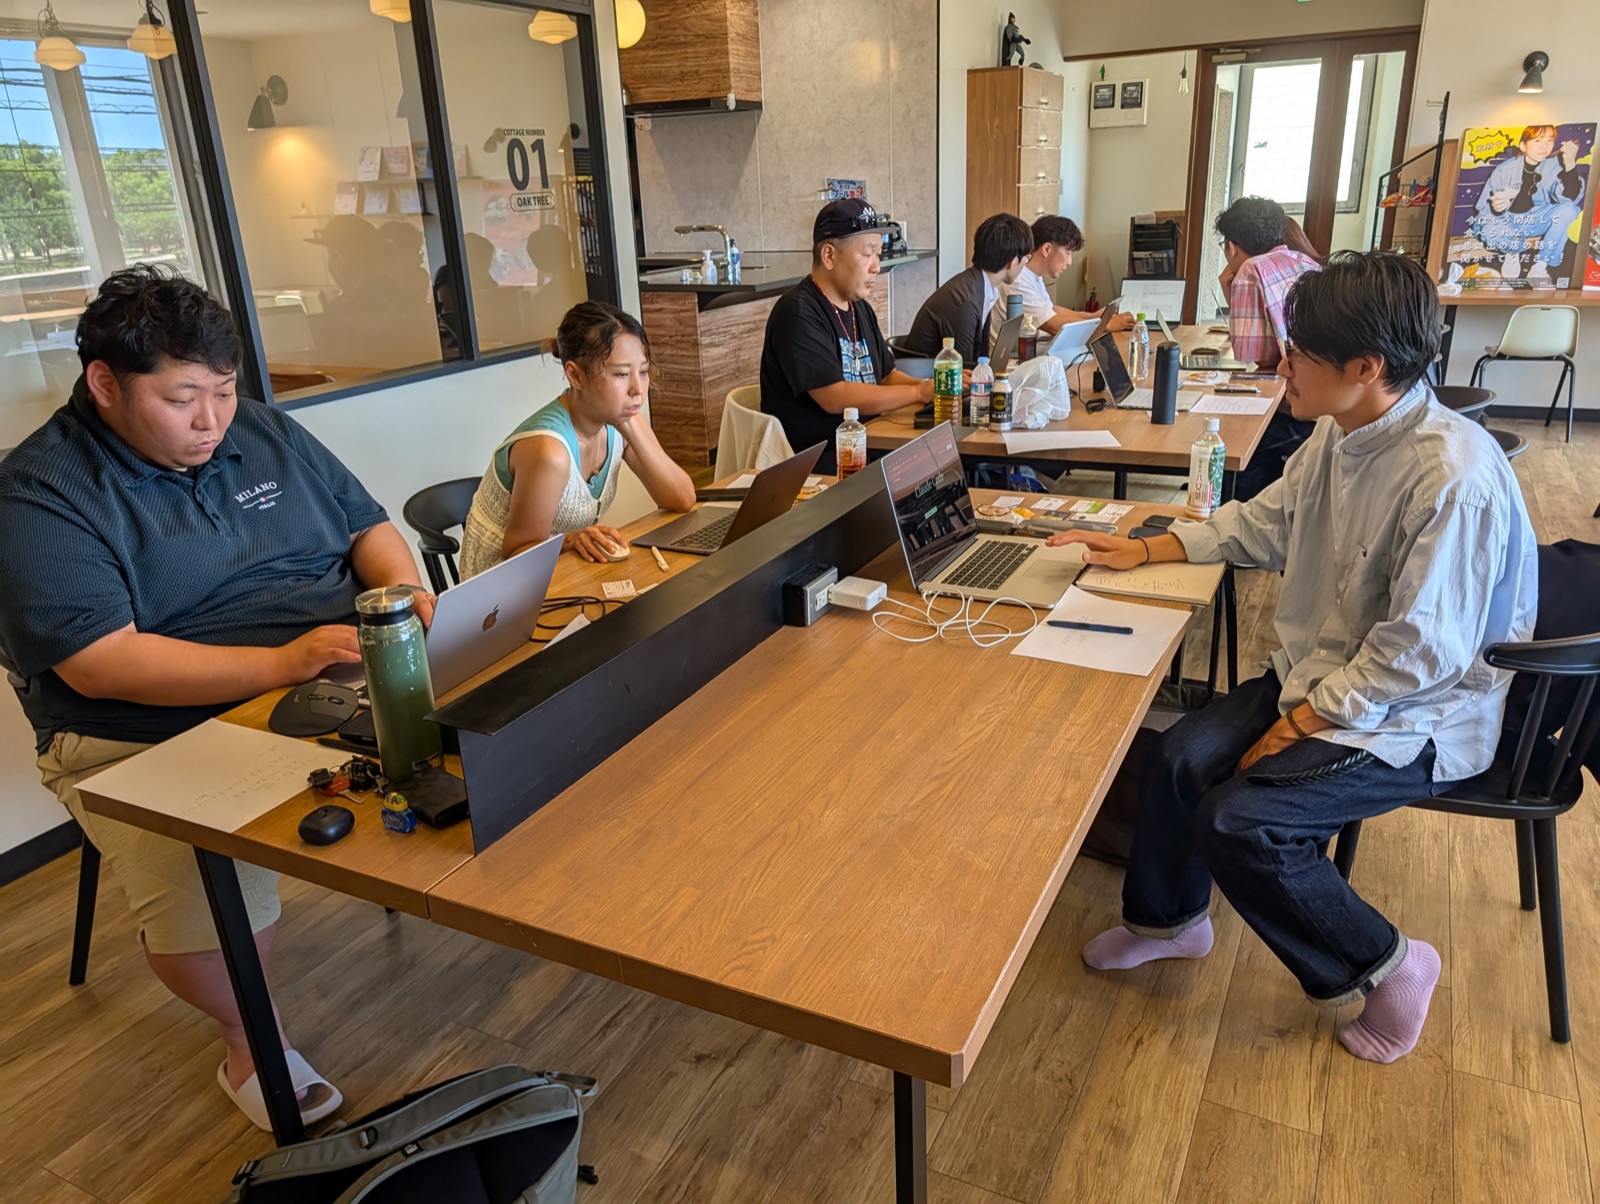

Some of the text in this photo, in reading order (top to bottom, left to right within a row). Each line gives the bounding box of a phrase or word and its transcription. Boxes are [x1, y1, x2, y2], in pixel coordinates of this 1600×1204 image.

[507, 138, 549, 191] 01
[517, 195, 549, 207] OAK TREE
[1465, 214, 1560, 226] 今はもう閉店して
[1463, 228, 1534, 238] 食べられない
[1461, 240, 1558, 250] 思い出の店の話を
[914, 472, 945, 499] Claude Code
[235, 482, 277, 503] MILANO
[258, 502, 276, 511] ITALIA
